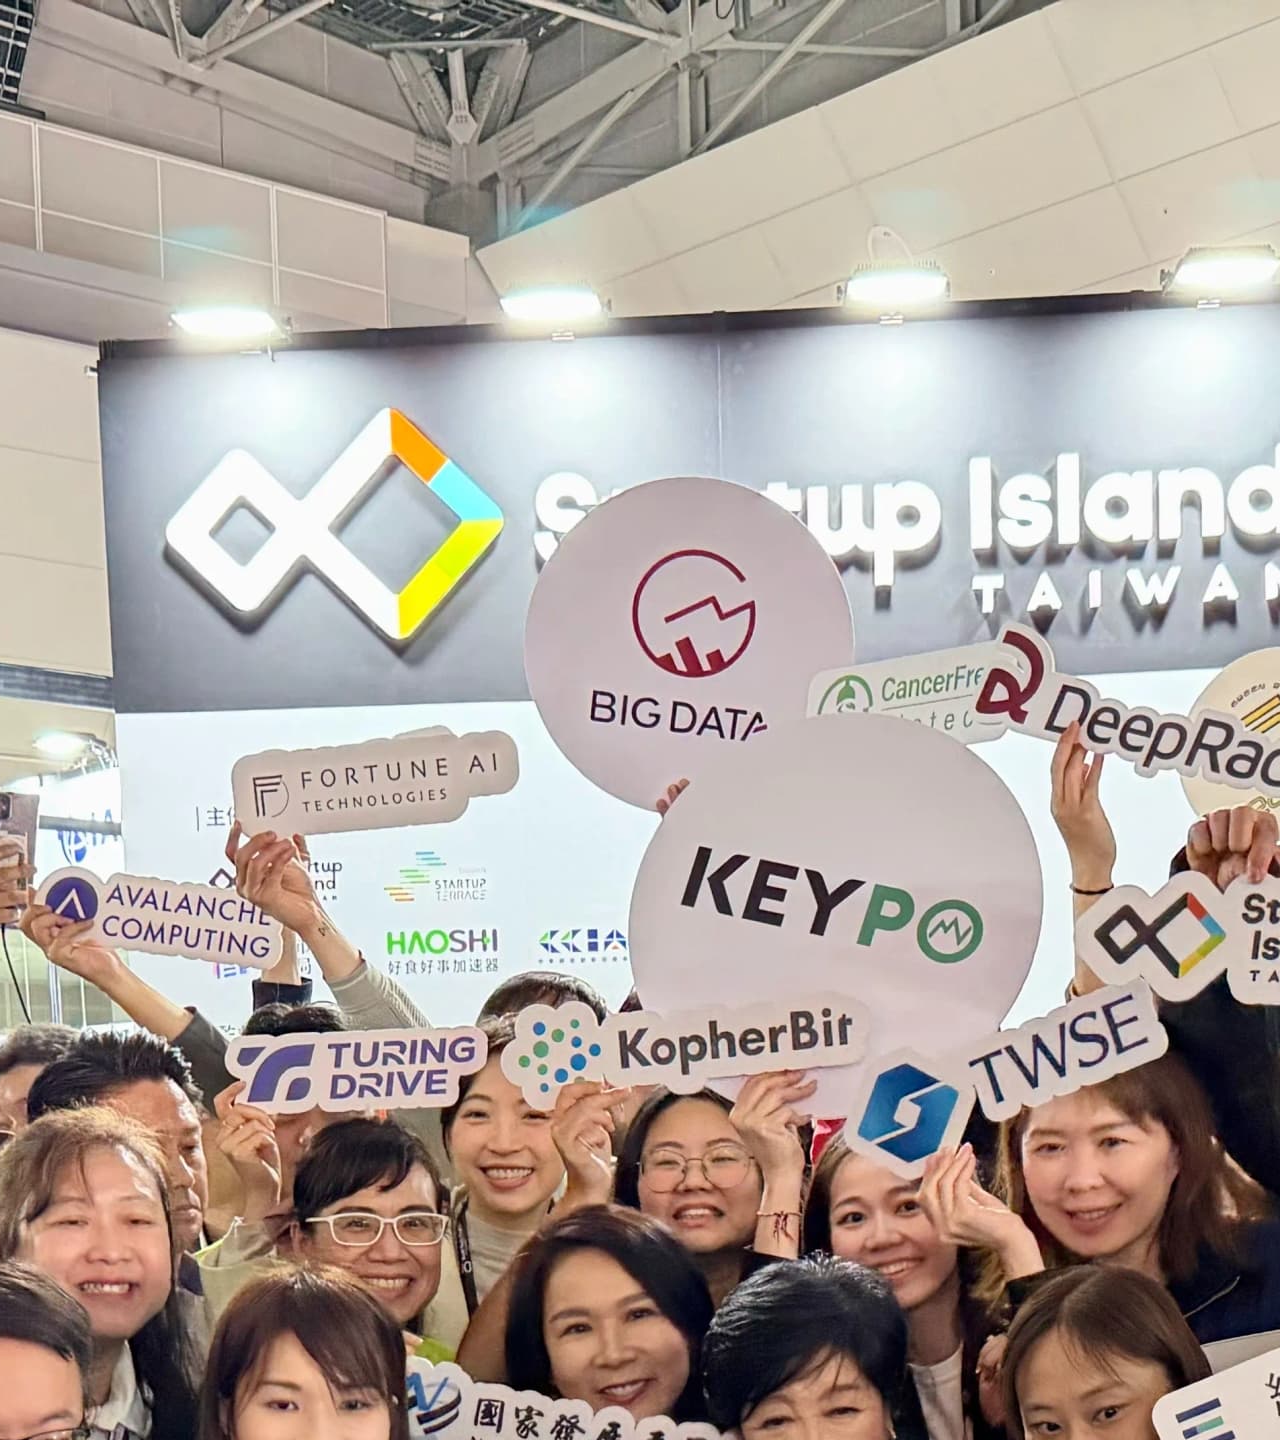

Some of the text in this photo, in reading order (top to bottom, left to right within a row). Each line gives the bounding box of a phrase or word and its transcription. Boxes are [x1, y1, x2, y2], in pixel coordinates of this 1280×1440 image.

[881, 664, 985, 703] CancerFre
[589, 690, 768, 743] BIG DATA
[300, 752, 500, 790] FORTUNE AI
[302, 787, 449, 814] TECHNOLOGIES
[680, 846, 984, 964] KEYPO
[102, 915, 271, 959] COMPUTING
[386, 928, 499, 955] HAOSHI
[328, 1035, 476, 1070] TURING
[618, 1009, 853, 1075] KopherBit
[968, 993, 1149, 1105] TWSE
[329, 1069, 449, 1100] DRIVE
